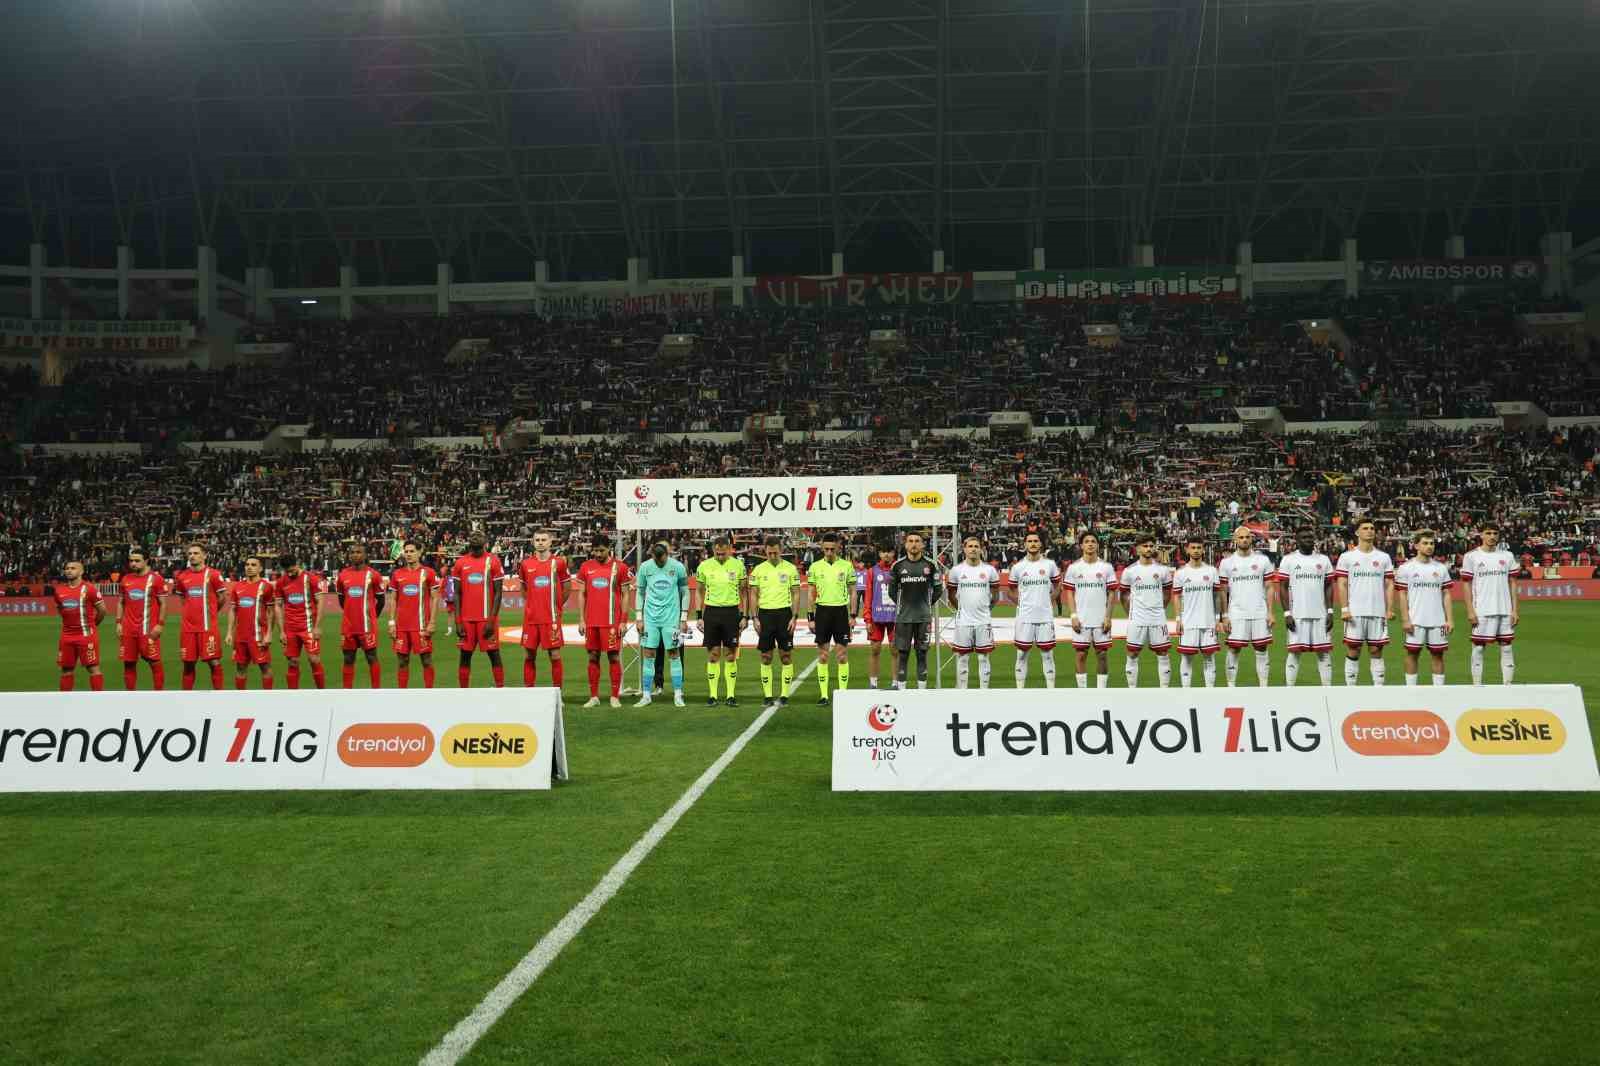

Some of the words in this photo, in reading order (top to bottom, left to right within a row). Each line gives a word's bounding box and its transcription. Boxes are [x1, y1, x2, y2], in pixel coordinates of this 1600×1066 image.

[1388, 264, 1504, 281] AMEDSPOR
[673, 488, 795, 516] trendyol
[852, 735, 916, 750] trendyol
[946, 708, 1201, 764] trendyol
[1352, 722, 1440, 744] trendyol
[345, 735, 428, 756] trendyol
